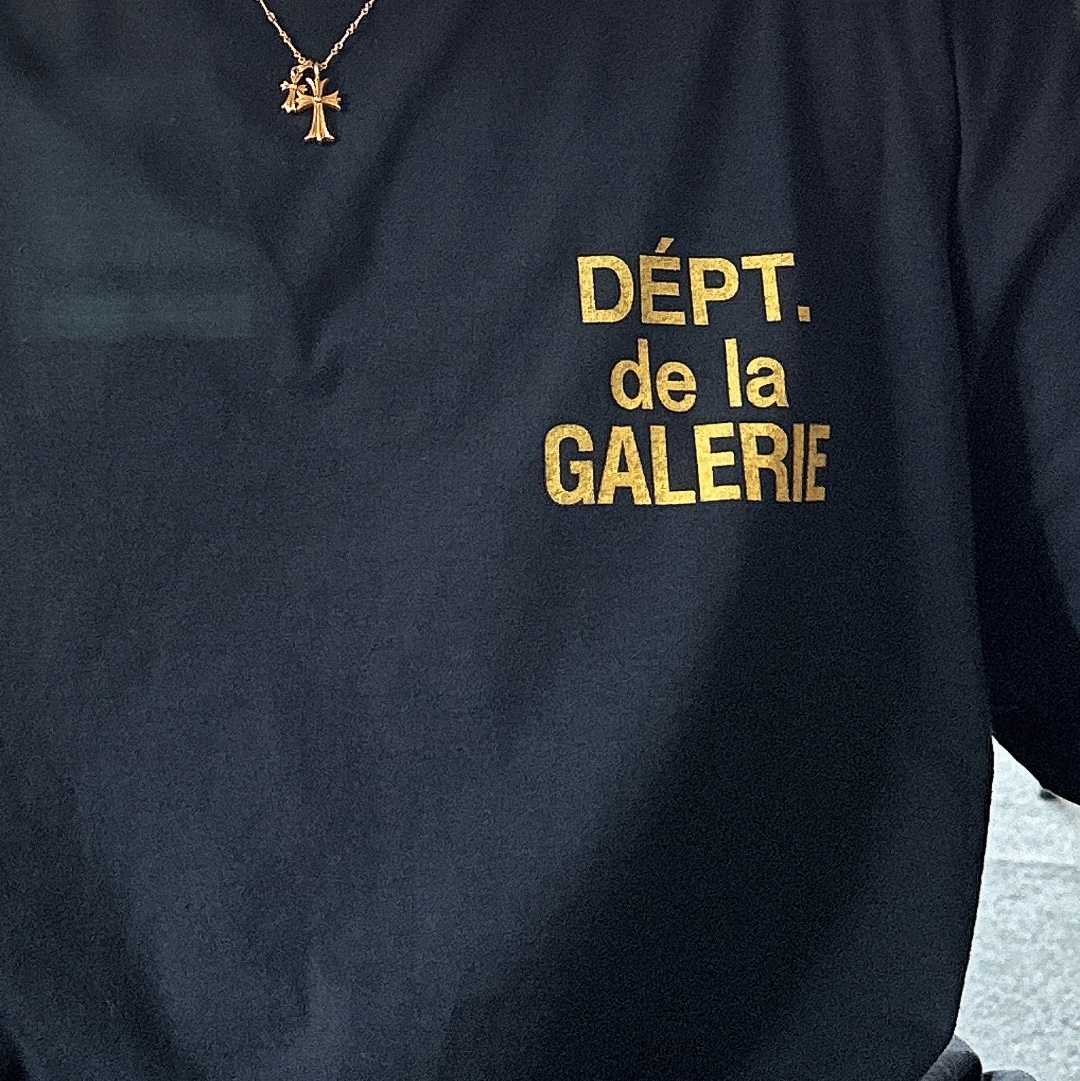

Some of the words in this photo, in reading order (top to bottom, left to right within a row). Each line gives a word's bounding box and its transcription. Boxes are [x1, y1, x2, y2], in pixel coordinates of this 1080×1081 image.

[577, 236, 811, 326] DÉPT.
[610, 338, 697, 412] de
[724, 337, 789, 408] la
[544, 421, 831, 506] GALERIE
